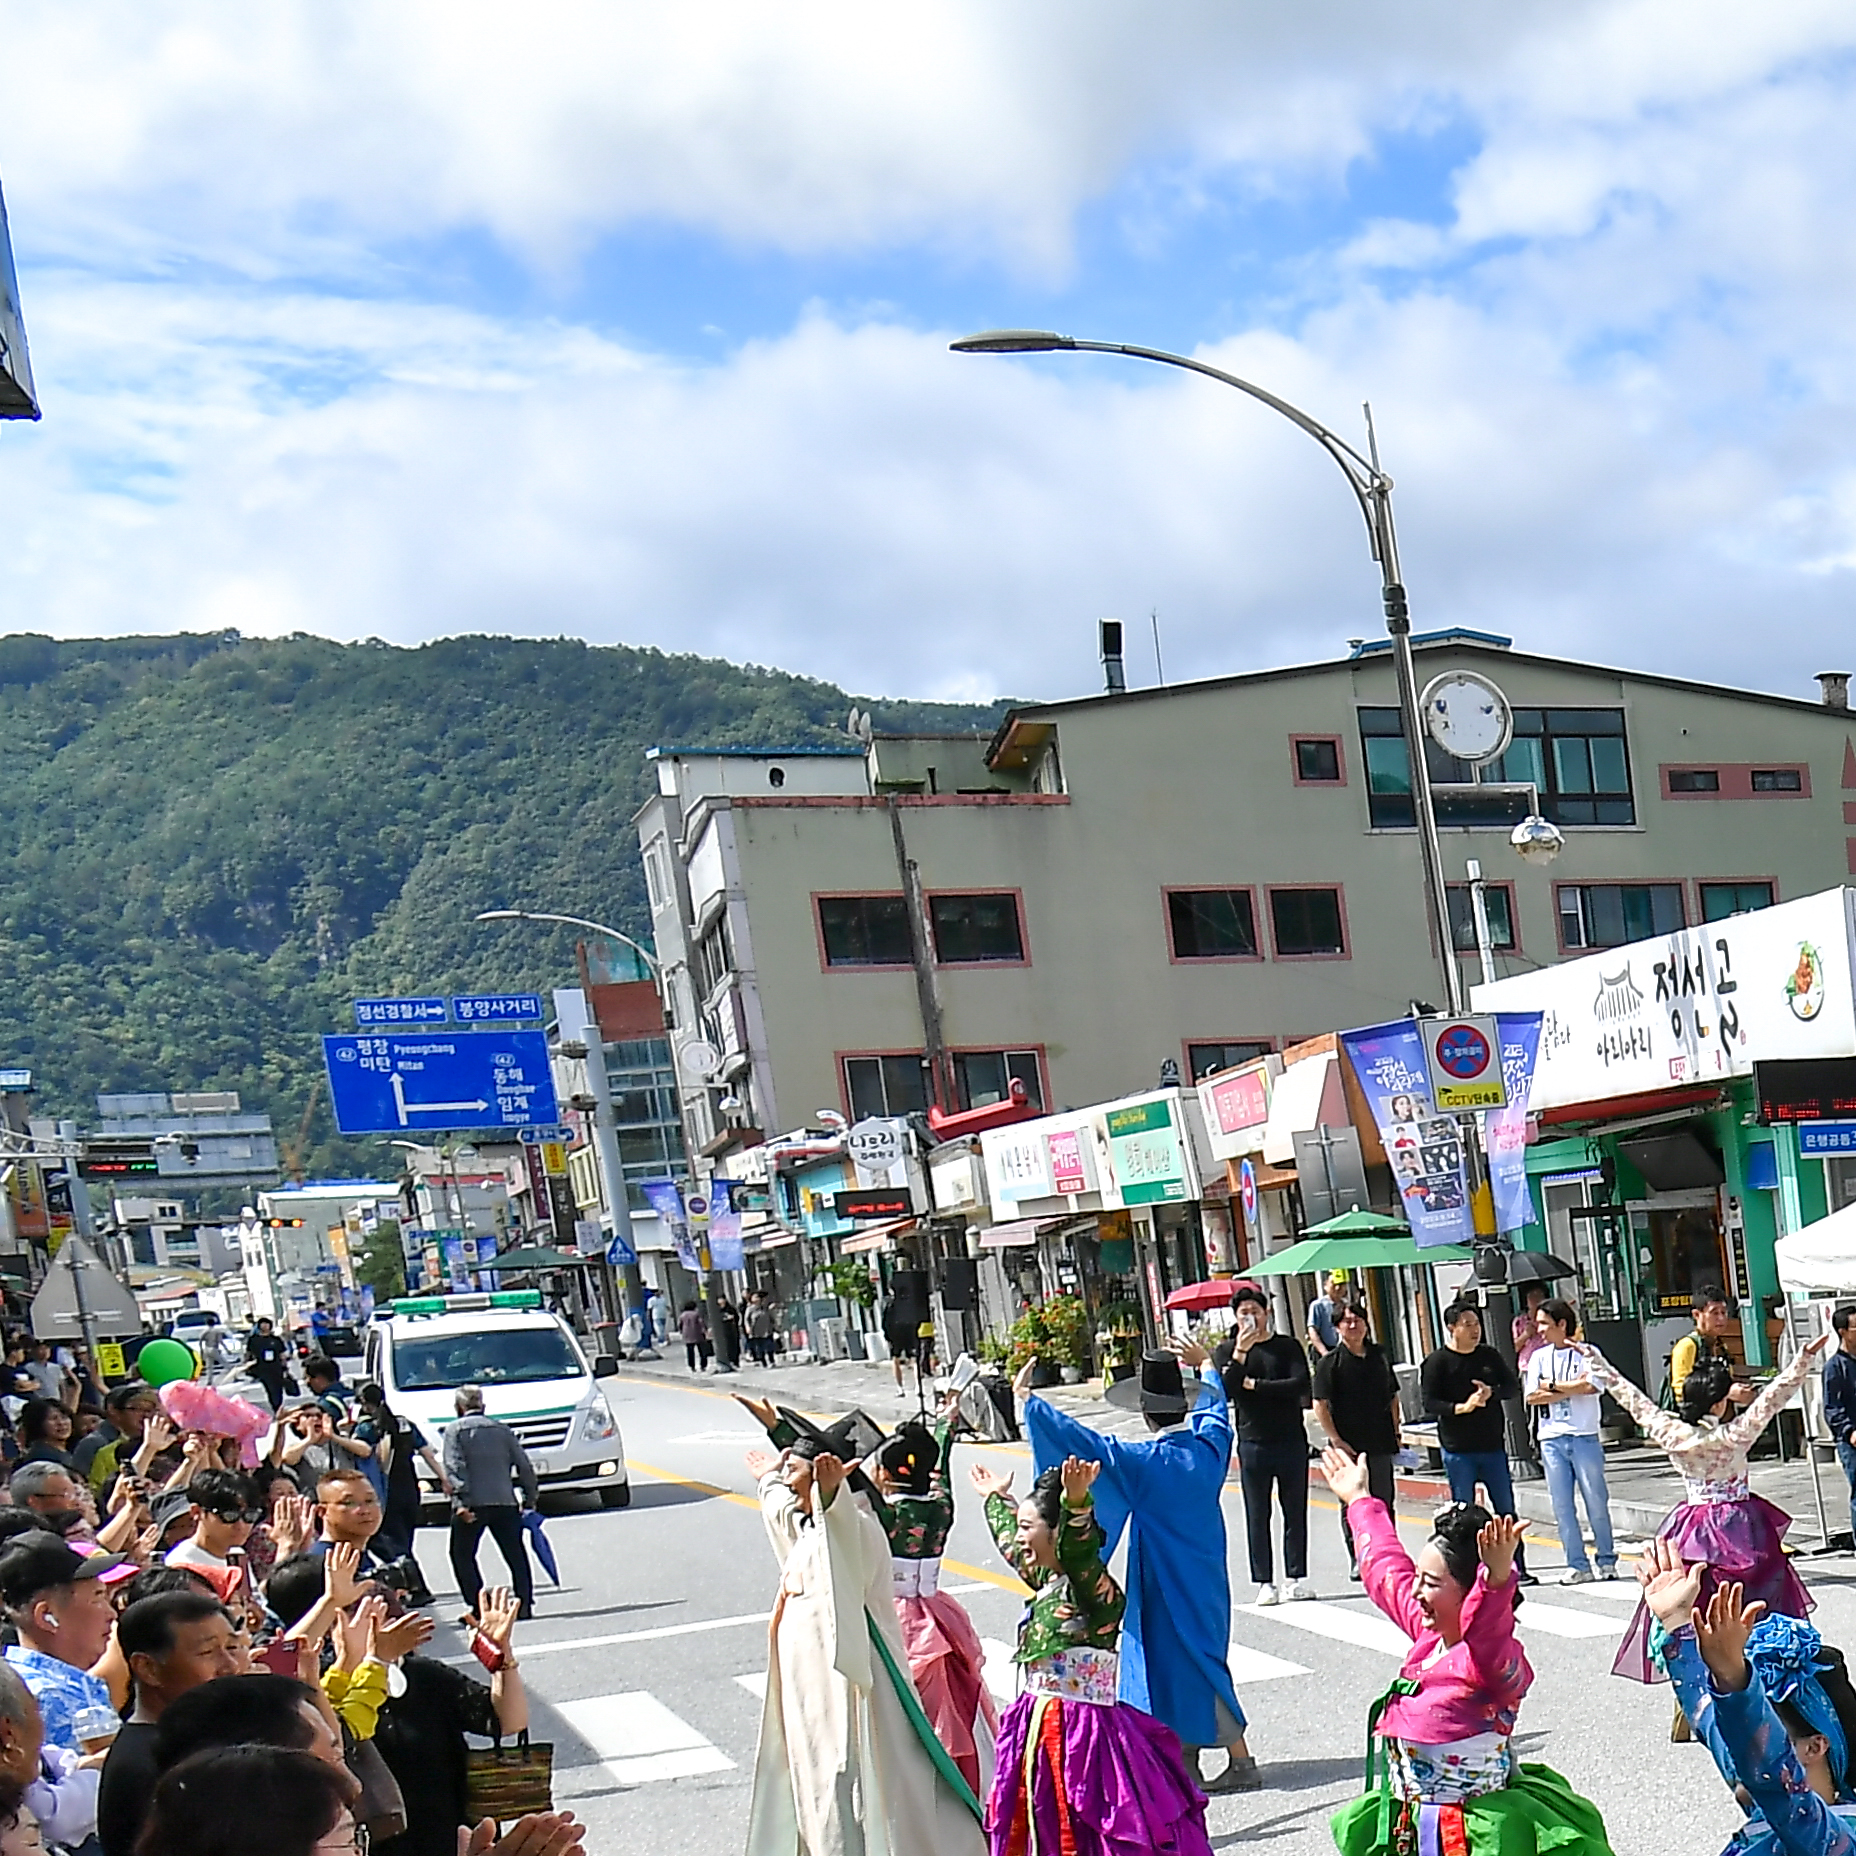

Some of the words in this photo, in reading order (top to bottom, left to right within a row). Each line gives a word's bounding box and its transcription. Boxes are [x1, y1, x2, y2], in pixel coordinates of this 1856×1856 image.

[459, 998, 536, 1018] 봉양사거리
[1597, 1026, 1652, 1067] 아리아리
[1653, 938, 1738, 1058] 정선골
[357, 1003, 427, 1020] 정선경찰서
[357, 1039, 388, 1055] 평창
[359, 1057, 391, 1072] 미탄
[493, 1068, 523, 1084] 동해
[497, 1096, 529, 1112] 임계
[1446, 1092, 1500, 1106] CCTV단속중
